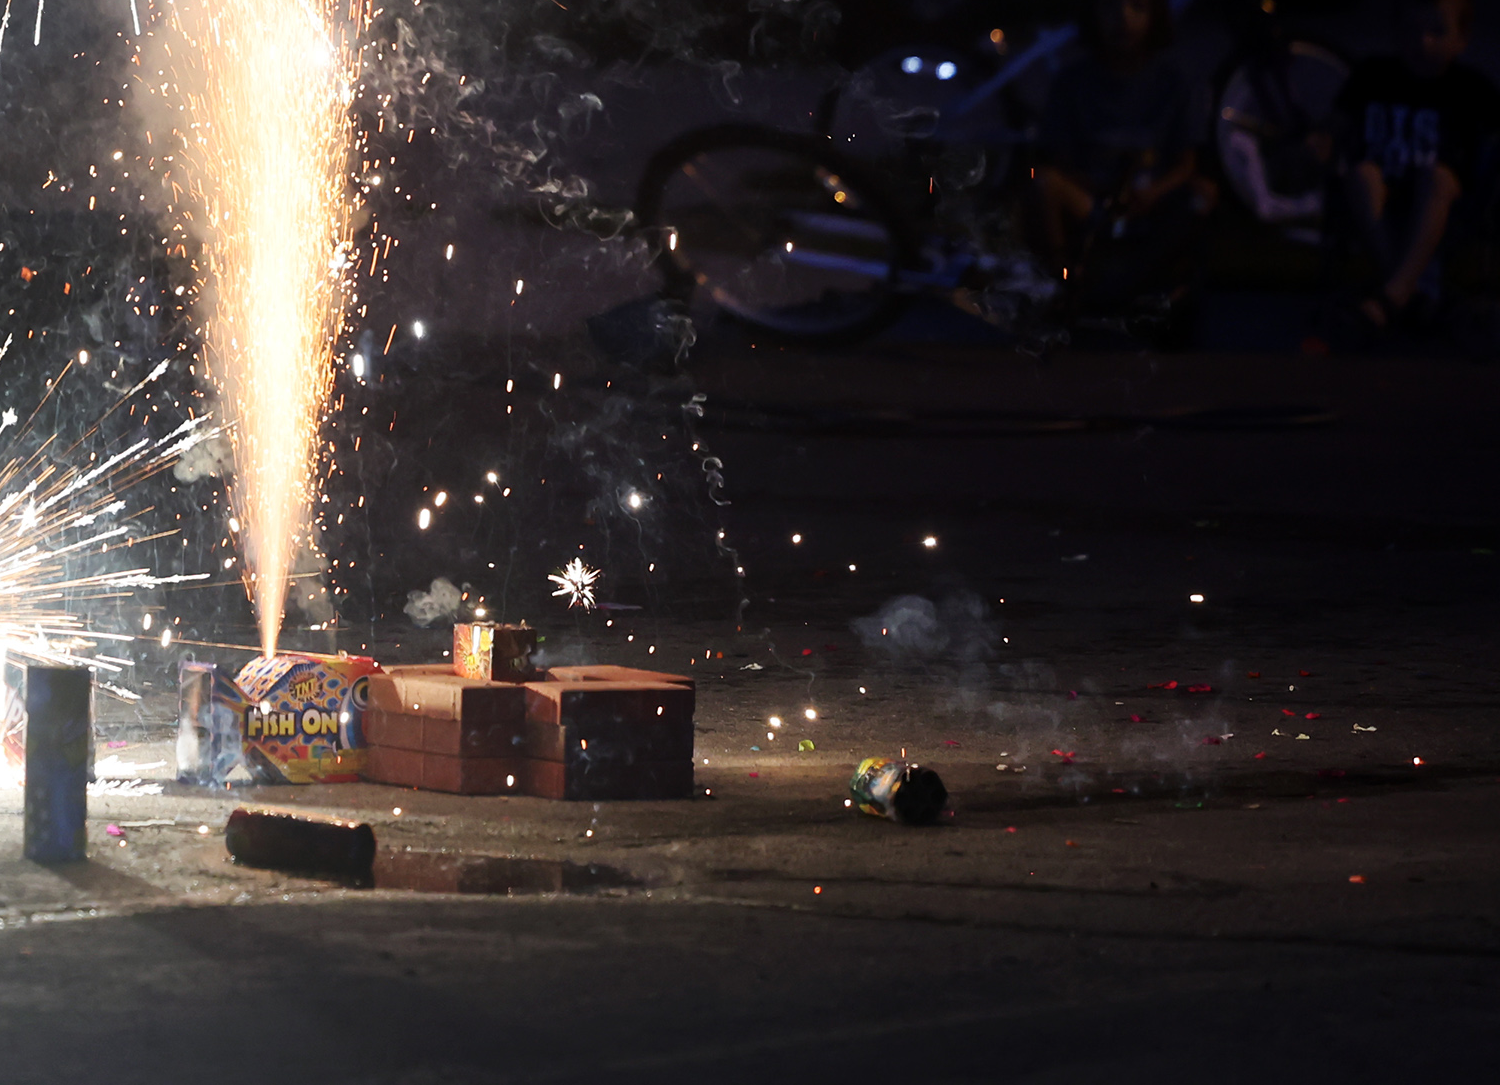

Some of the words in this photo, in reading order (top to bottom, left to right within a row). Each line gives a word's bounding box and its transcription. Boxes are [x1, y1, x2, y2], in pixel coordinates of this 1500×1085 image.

[295, 678, 316, 698] TNT
[248, 711, 295, 736] FISH
[302, 709, 338, 734] ON
